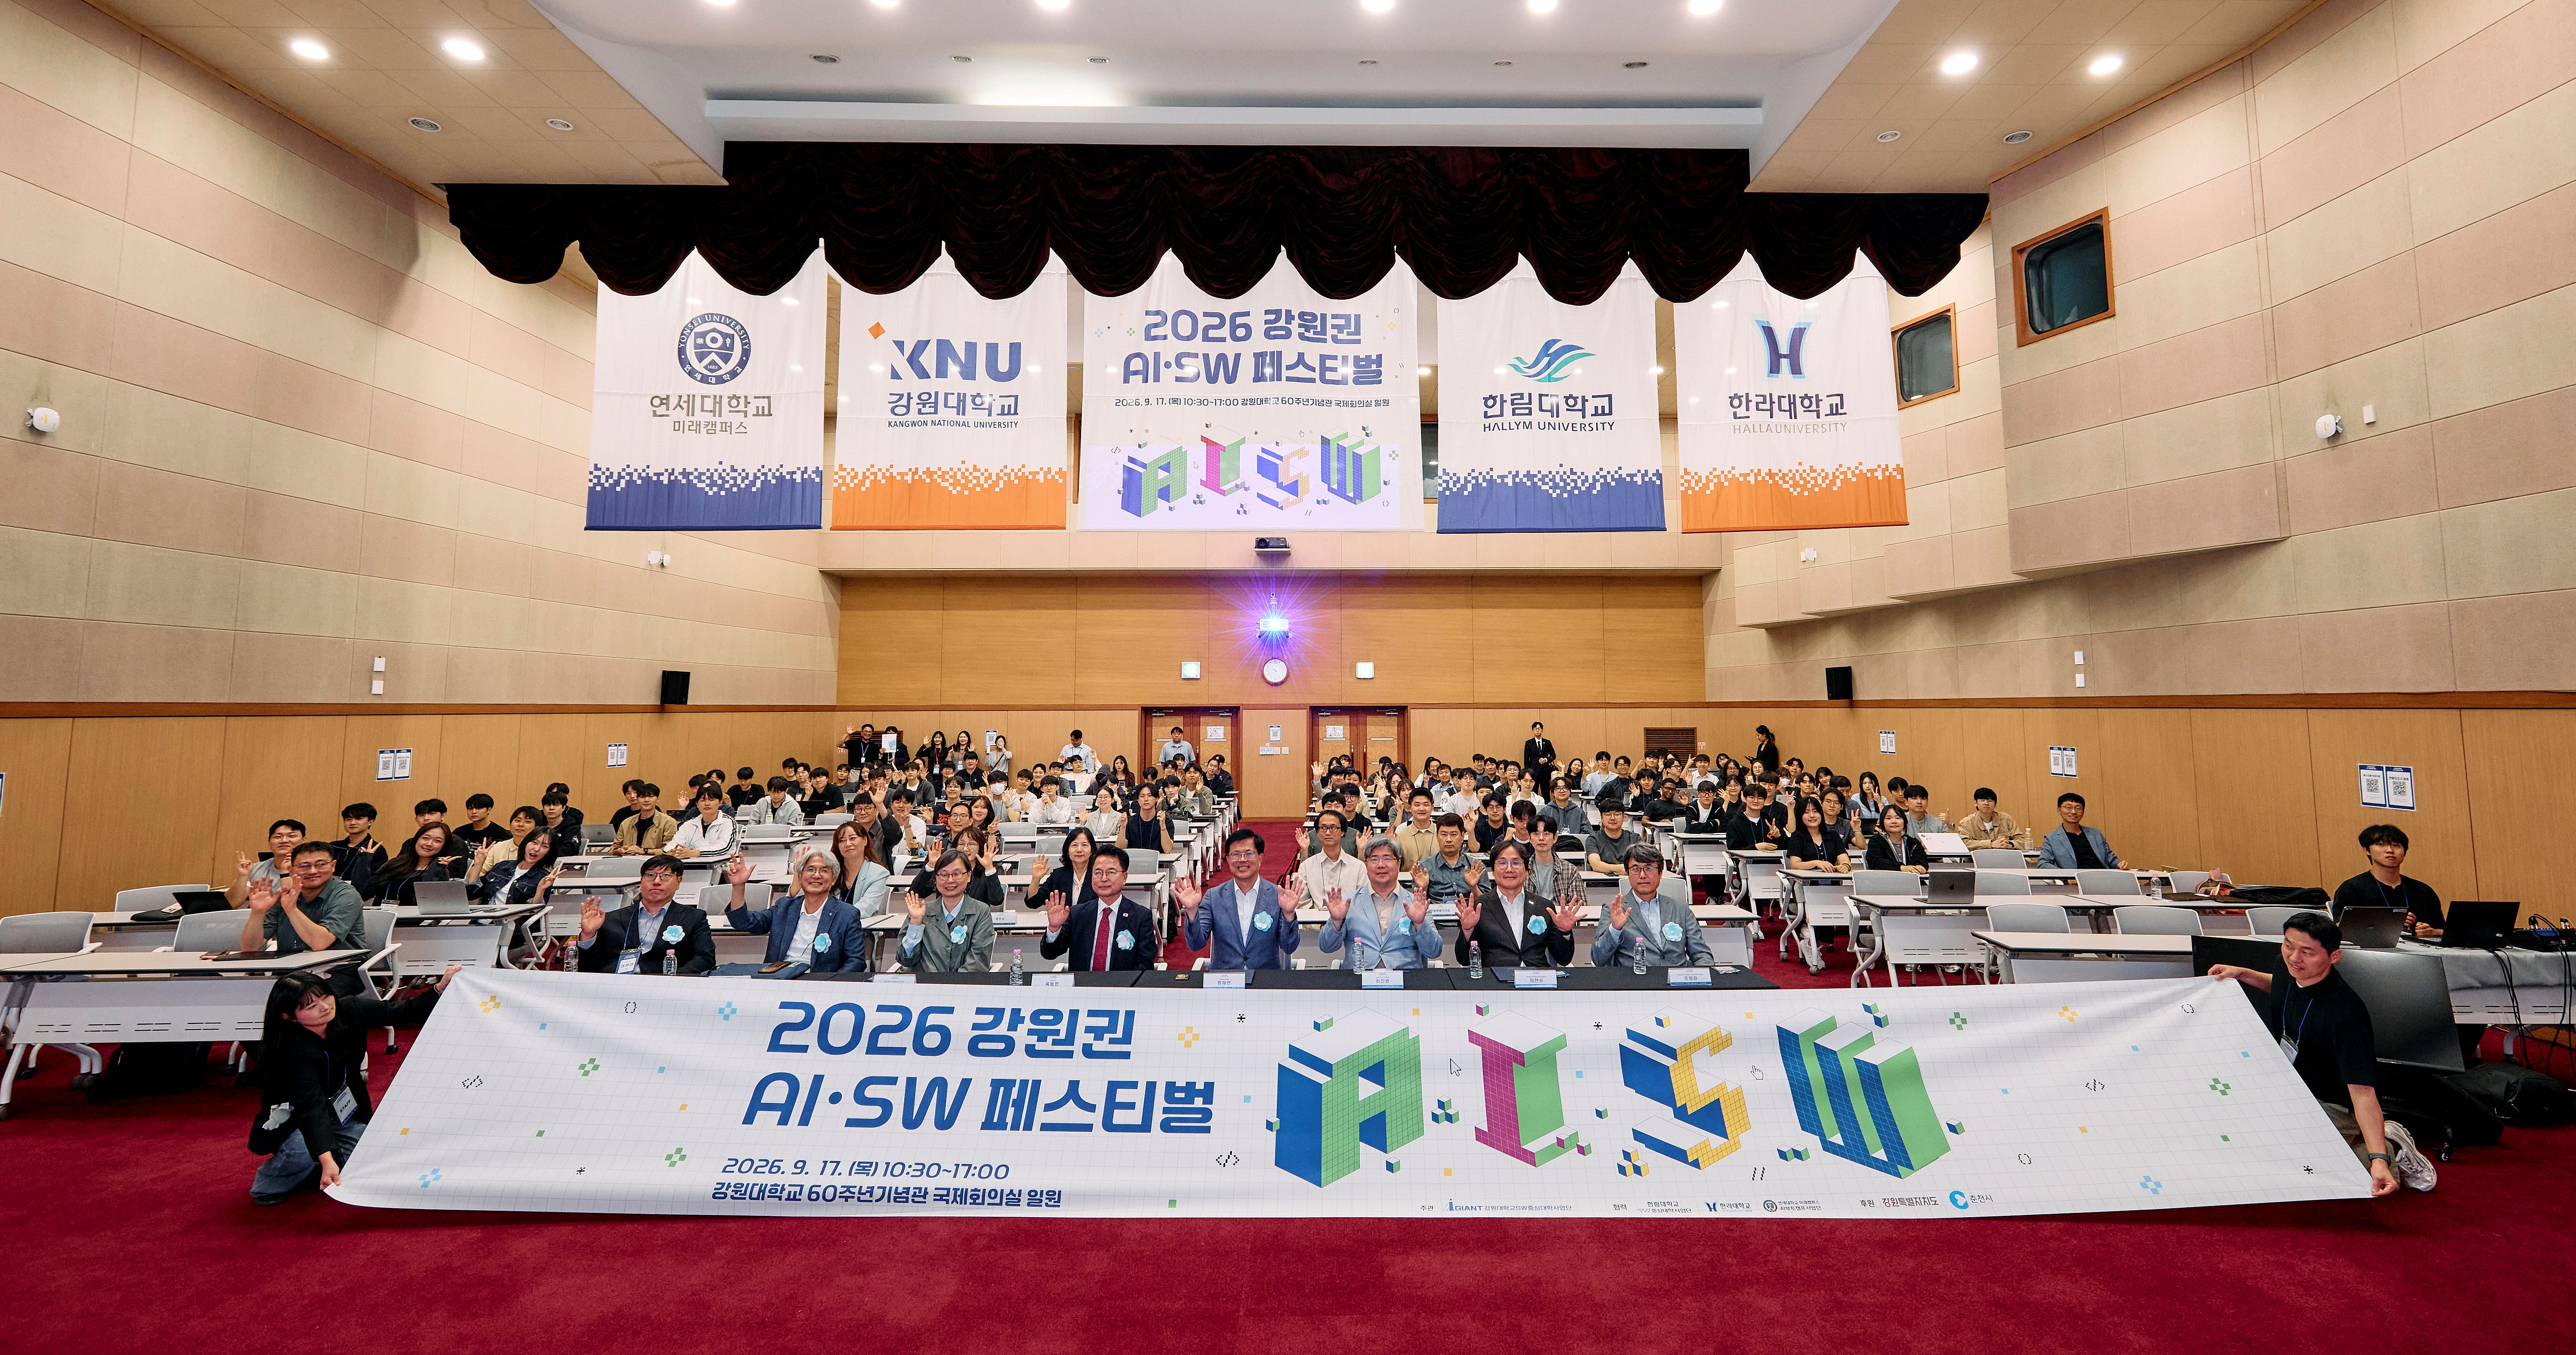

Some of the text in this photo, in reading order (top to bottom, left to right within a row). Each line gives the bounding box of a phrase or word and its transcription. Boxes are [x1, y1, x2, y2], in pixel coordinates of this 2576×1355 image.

[679, 314, 750, 349] YONSEI UNIVERSITY
[1145, 309, 1361, 344] 2026 강원권
[890, 339, 1021, 382] KNU
[1123, 351, 1382, 385] AI·SW 페스티벌
[684, 364, 742, 383] 연세대학교
[650, 395, 772, 418] 연세대학교
[888, 391, 1018, 416] 강원대학교
[1282, 398, 1332, 407] 60주년기념관
[1483, 393, 1612, 418] 한림대학교
[1729, 393, 1847, 419] 한라대학교
[673, 421, 747, 434] 미래캠퍼스
[1484, 421, 1614, 432] HALLYM UNIVERSITY
[1734, 422, 1847, 434] HALLA UNIVERSITY
[767, 1002, 1135, 1059] 2026 강원권
[742, 1072, 1214, 1133] AI·SW 페스티벌
[721, 1158, 1009, 1179] 2026. 9. 17. (목) 10:30~17:00
[712, 1182, 1061, 1207] 강원대학교 60주년기념관 국제회의실 일원
[1882, 1197, 1939, 1207] 강원특별자치도
[1970, 1195, 1993, 1203] 춘천시
